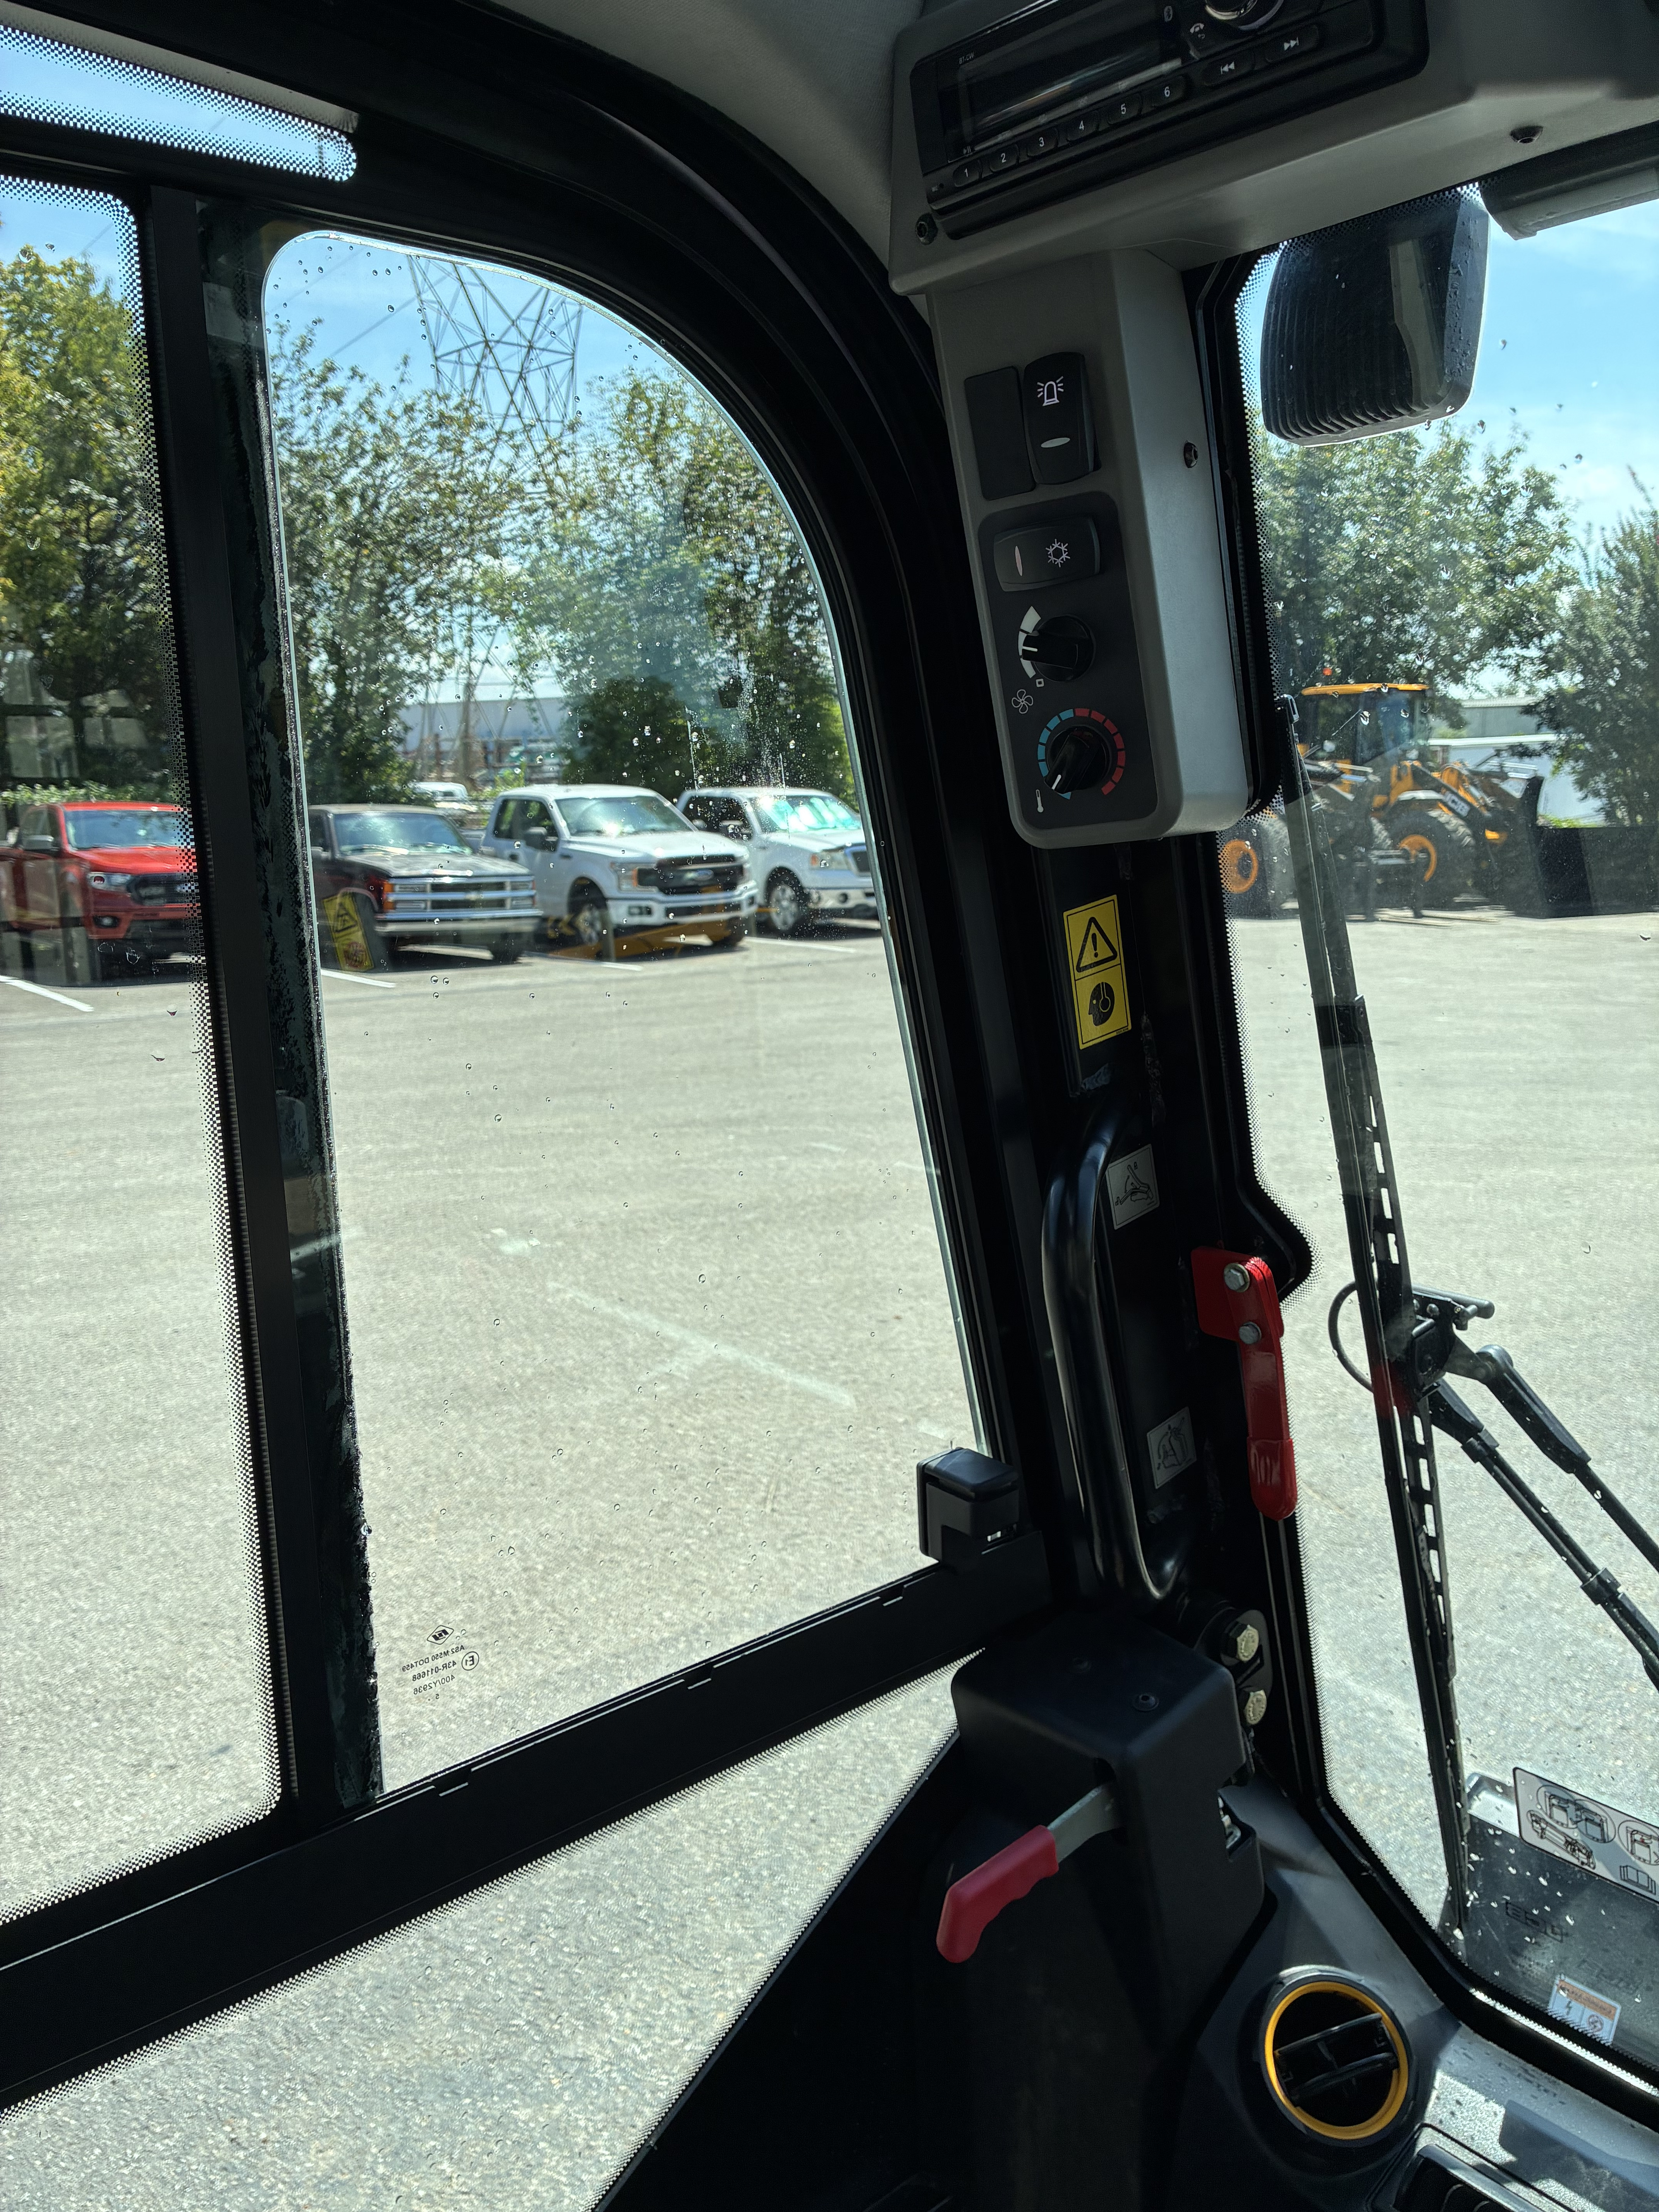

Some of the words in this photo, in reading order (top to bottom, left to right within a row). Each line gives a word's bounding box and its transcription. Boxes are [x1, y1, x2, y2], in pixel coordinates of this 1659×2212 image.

[1164, 86, 1170, 97] 6
[1120, 103, 1127, 114] 5
[1079, 120, 1084, 131] 4
[1038, 136, 1045, 147] 3
[1000, 152, 1006, 163] 2
[964, 168, 969, 177] 1
